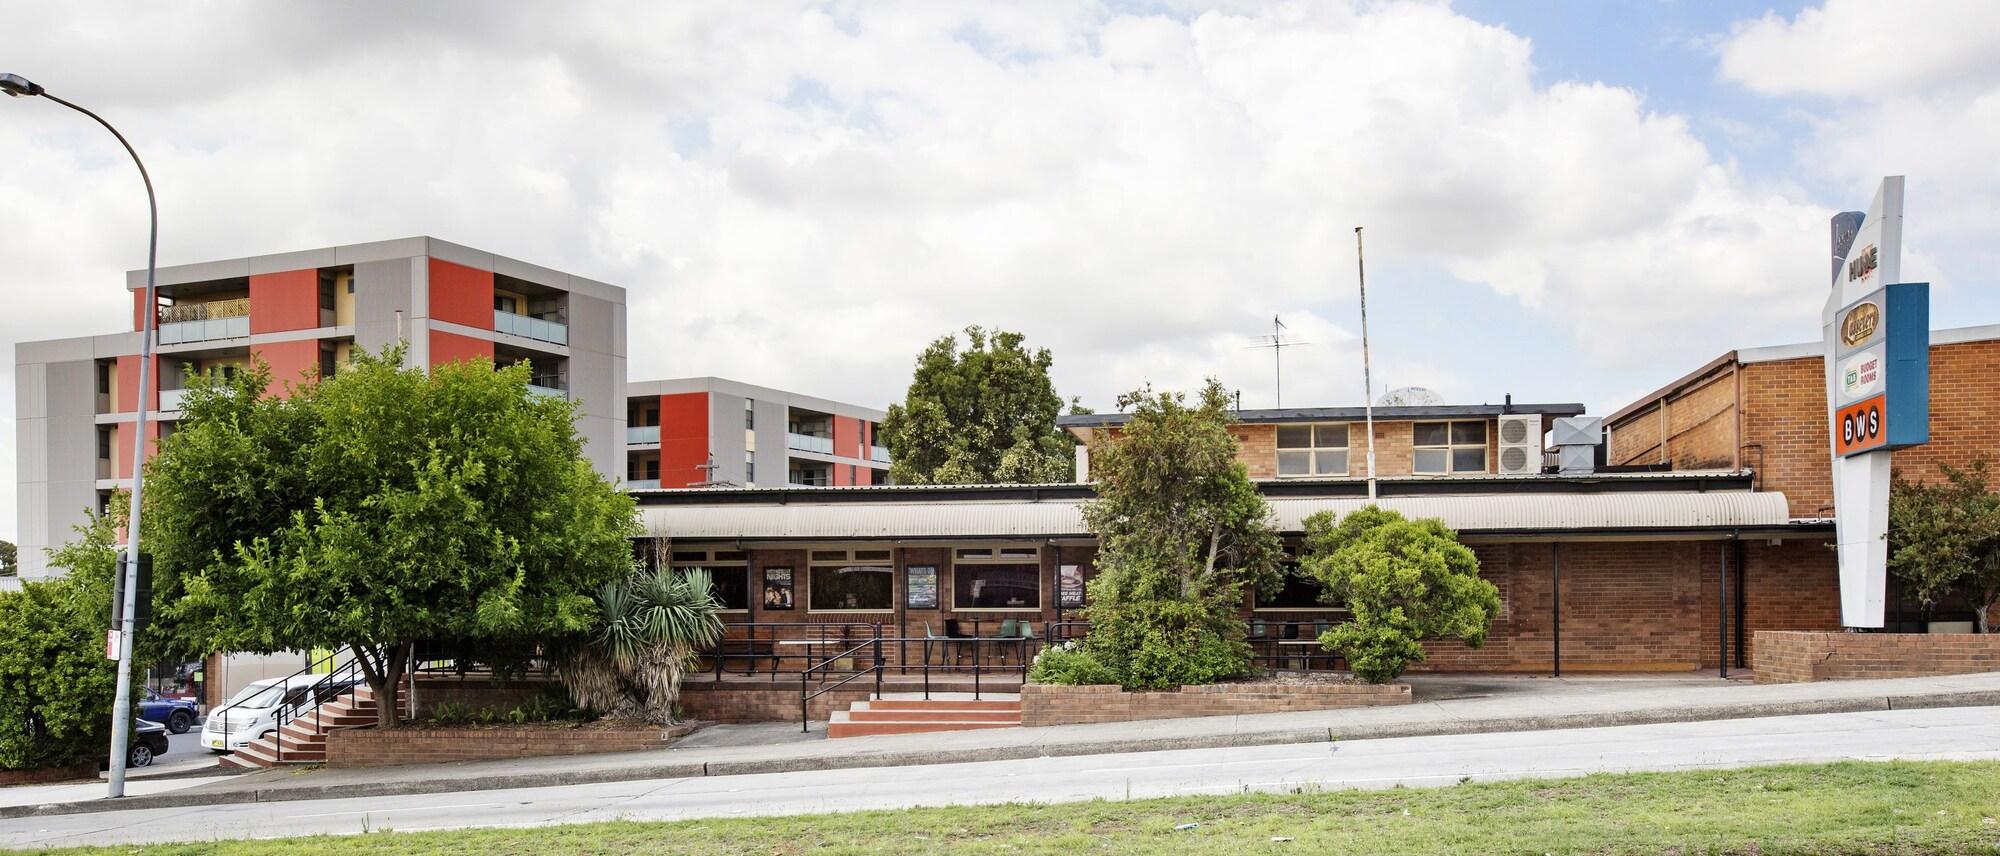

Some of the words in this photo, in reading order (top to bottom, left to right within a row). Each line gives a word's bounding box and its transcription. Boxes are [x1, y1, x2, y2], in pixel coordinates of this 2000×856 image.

[1861, 358, 1878, 374] BUDGET
[1861, 370, 1877, 385] ROOMS
[1845, 410, 1877, 441] BWS
